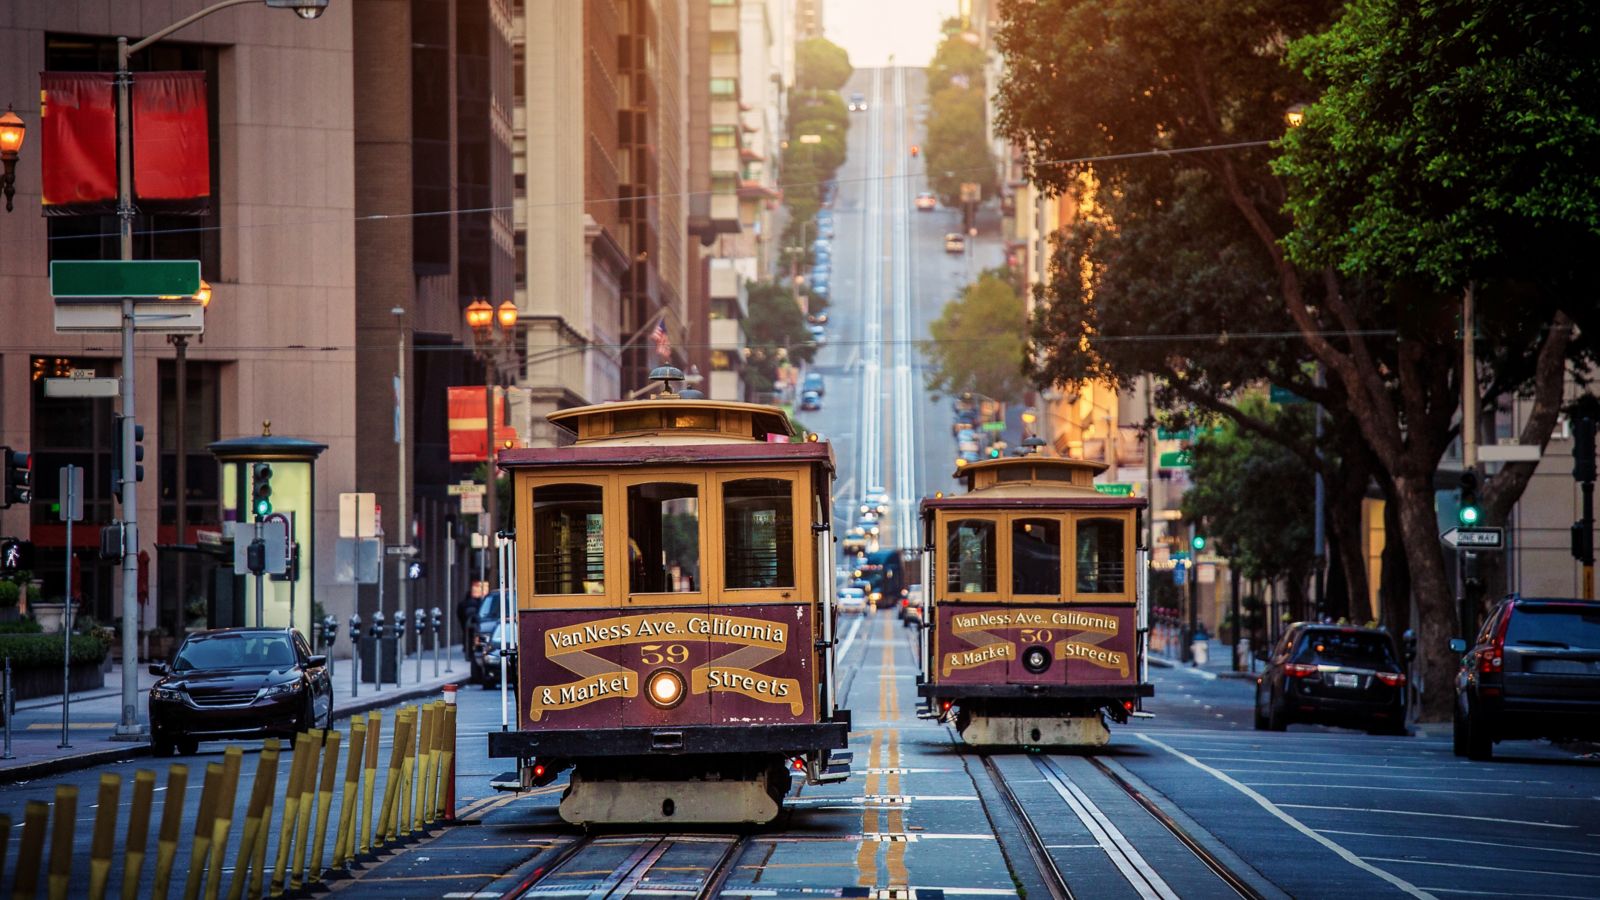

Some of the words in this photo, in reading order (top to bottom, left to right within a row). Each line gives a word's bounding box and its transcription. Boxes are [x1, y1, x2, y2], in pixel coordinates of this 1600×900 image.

[955, 616, 979, 628] Van
[980, 613, 1012, 625] Ness
[1052, 612, 1117, 630] California
[549, 630, 583, 650] Van
[584, 622, 632, 646] Ness
[687, 617, 784, 643] California
[1020, 629, 1053, 644] 50
[640, 644, 690, 665] 59
[951, 655, 961, 666] &
[963, 645, 1010, 664] Market
[1066, 643, 1121, 665] Streets
[541, 688, 556, 705] &
[559, 675, 630, 705] Market
[707, 670, 789, 698] Streets
